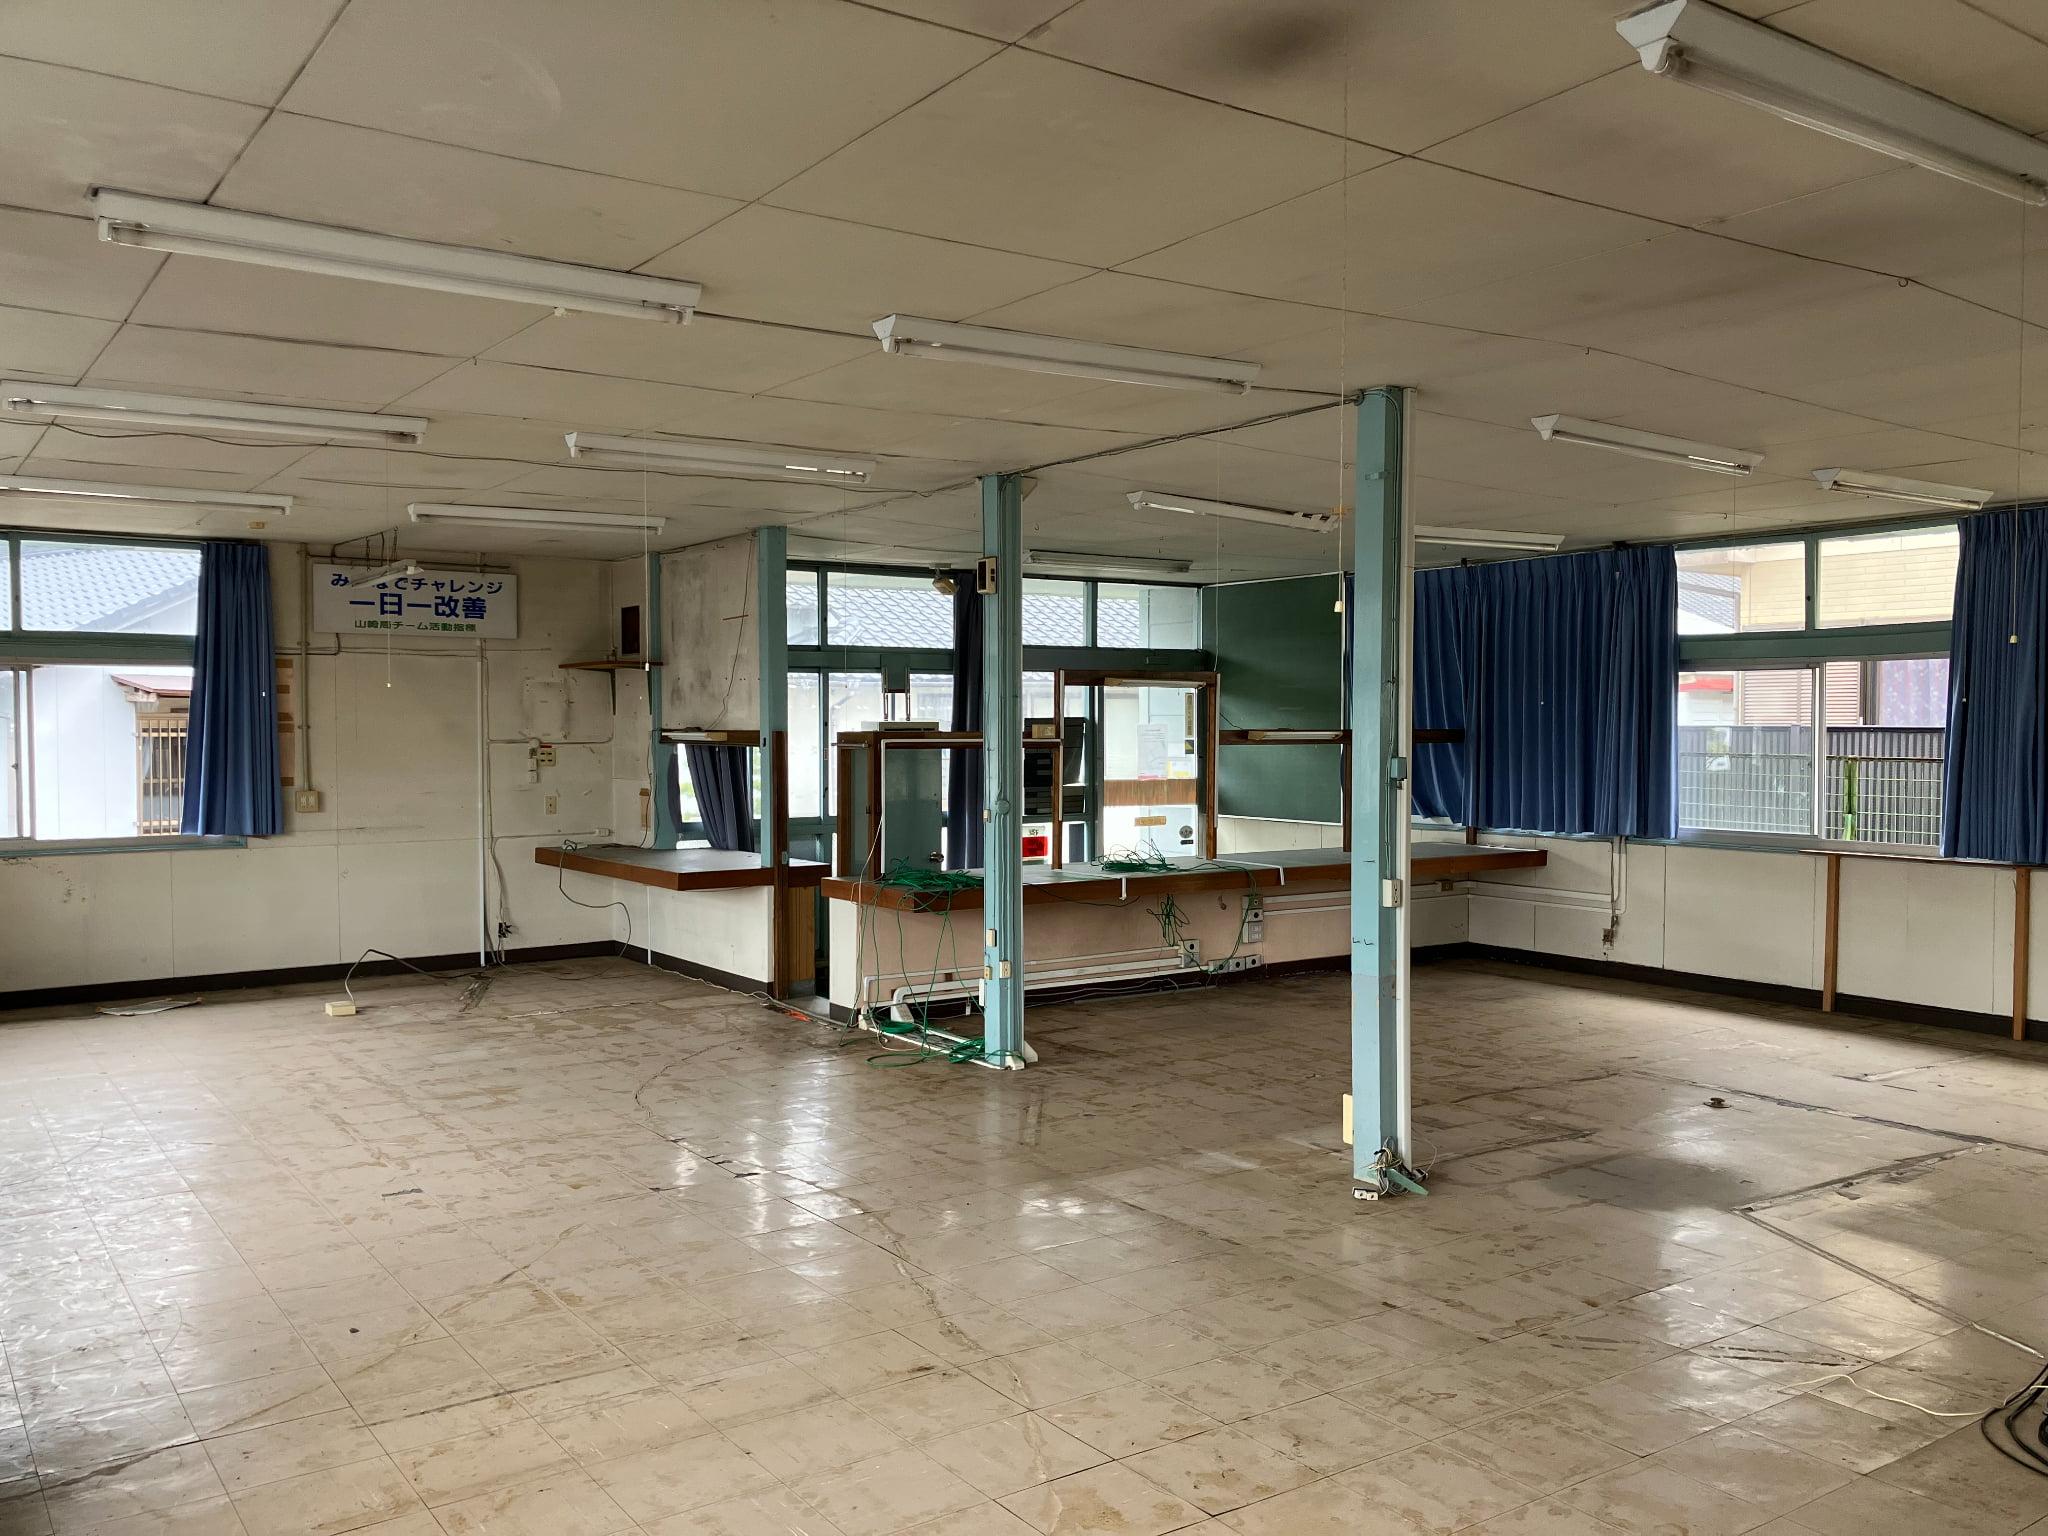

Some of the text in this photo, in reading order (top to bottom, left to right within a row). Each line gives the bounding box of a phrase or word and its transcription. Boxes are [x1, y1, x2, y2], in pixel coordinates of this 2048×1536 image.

[331, 573, 503, 594] みでチャレンジ
[350, 593, 487, 620] 一日一改善
